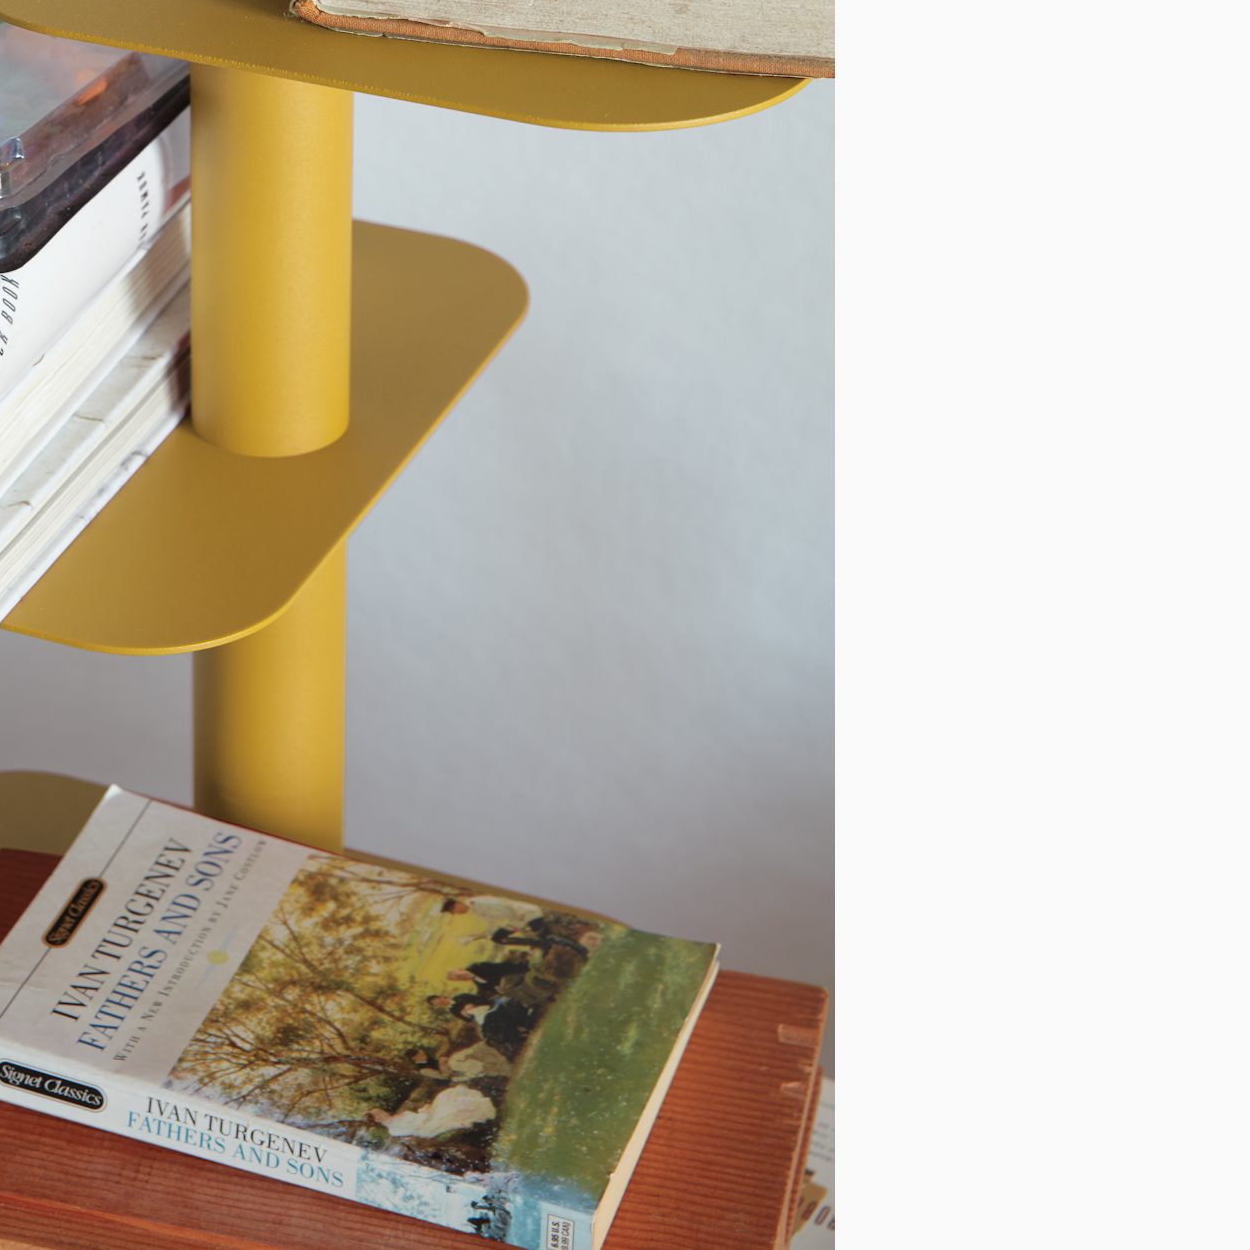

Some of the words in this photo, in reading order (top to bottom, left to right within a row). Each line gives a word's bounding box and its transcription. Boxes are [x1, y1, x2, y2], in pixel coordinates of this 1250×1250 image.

[0, 274, 20, 325] BOOK
[50, 963, 111, 1022] IVAN
[90, 837, 193, 961] TURGENEV
[76, 946, 168, 1051] FATHERS
[153, 892, 202, 945] AND
[186, 831, 243, 891] SONS
[0, 1064, 44, 1087] Signet
[44, 1078, 102, 1106] Classics
[126, 1110, 227, 1155] FATHERS
[232, 1142, 281, 1170] AND
[286, 1157, 345, 1188] SONS
[146, 1096, 199, 1127] IVAN
[203, 1113, 328, 1164] TURGENEV
